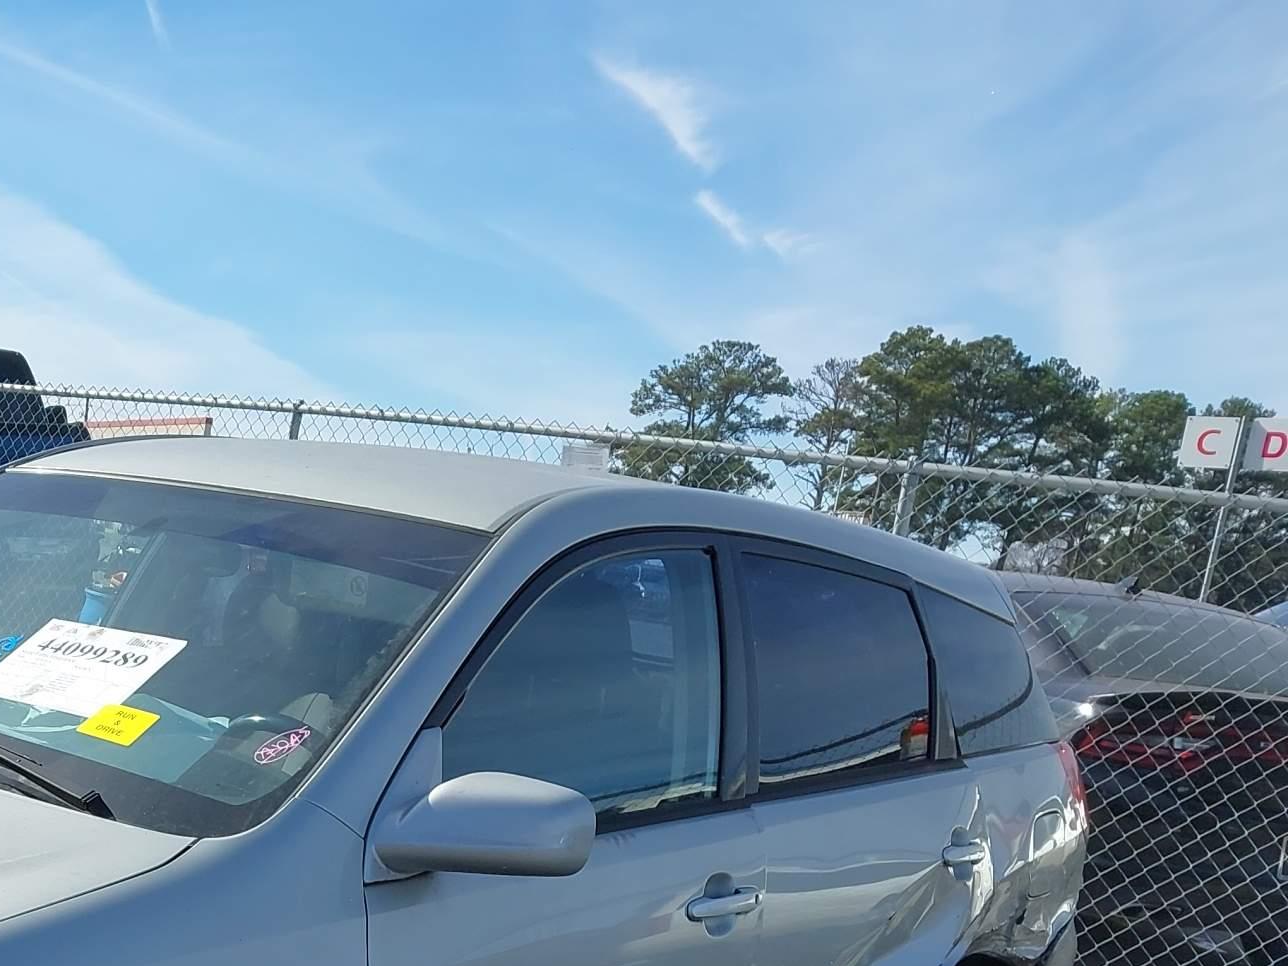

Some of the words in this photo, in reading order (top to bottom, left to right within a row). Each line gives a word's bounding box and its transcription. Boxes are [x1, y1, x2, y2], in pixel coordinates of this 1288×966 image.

[1197, 429, 1221, 455] C
[1261, 432, 1288, 458] D
[37, 637, 150, 669] 44099289
[115, 710, 137, 721] RUN
[95, 724, 125, 737] DRIVE
